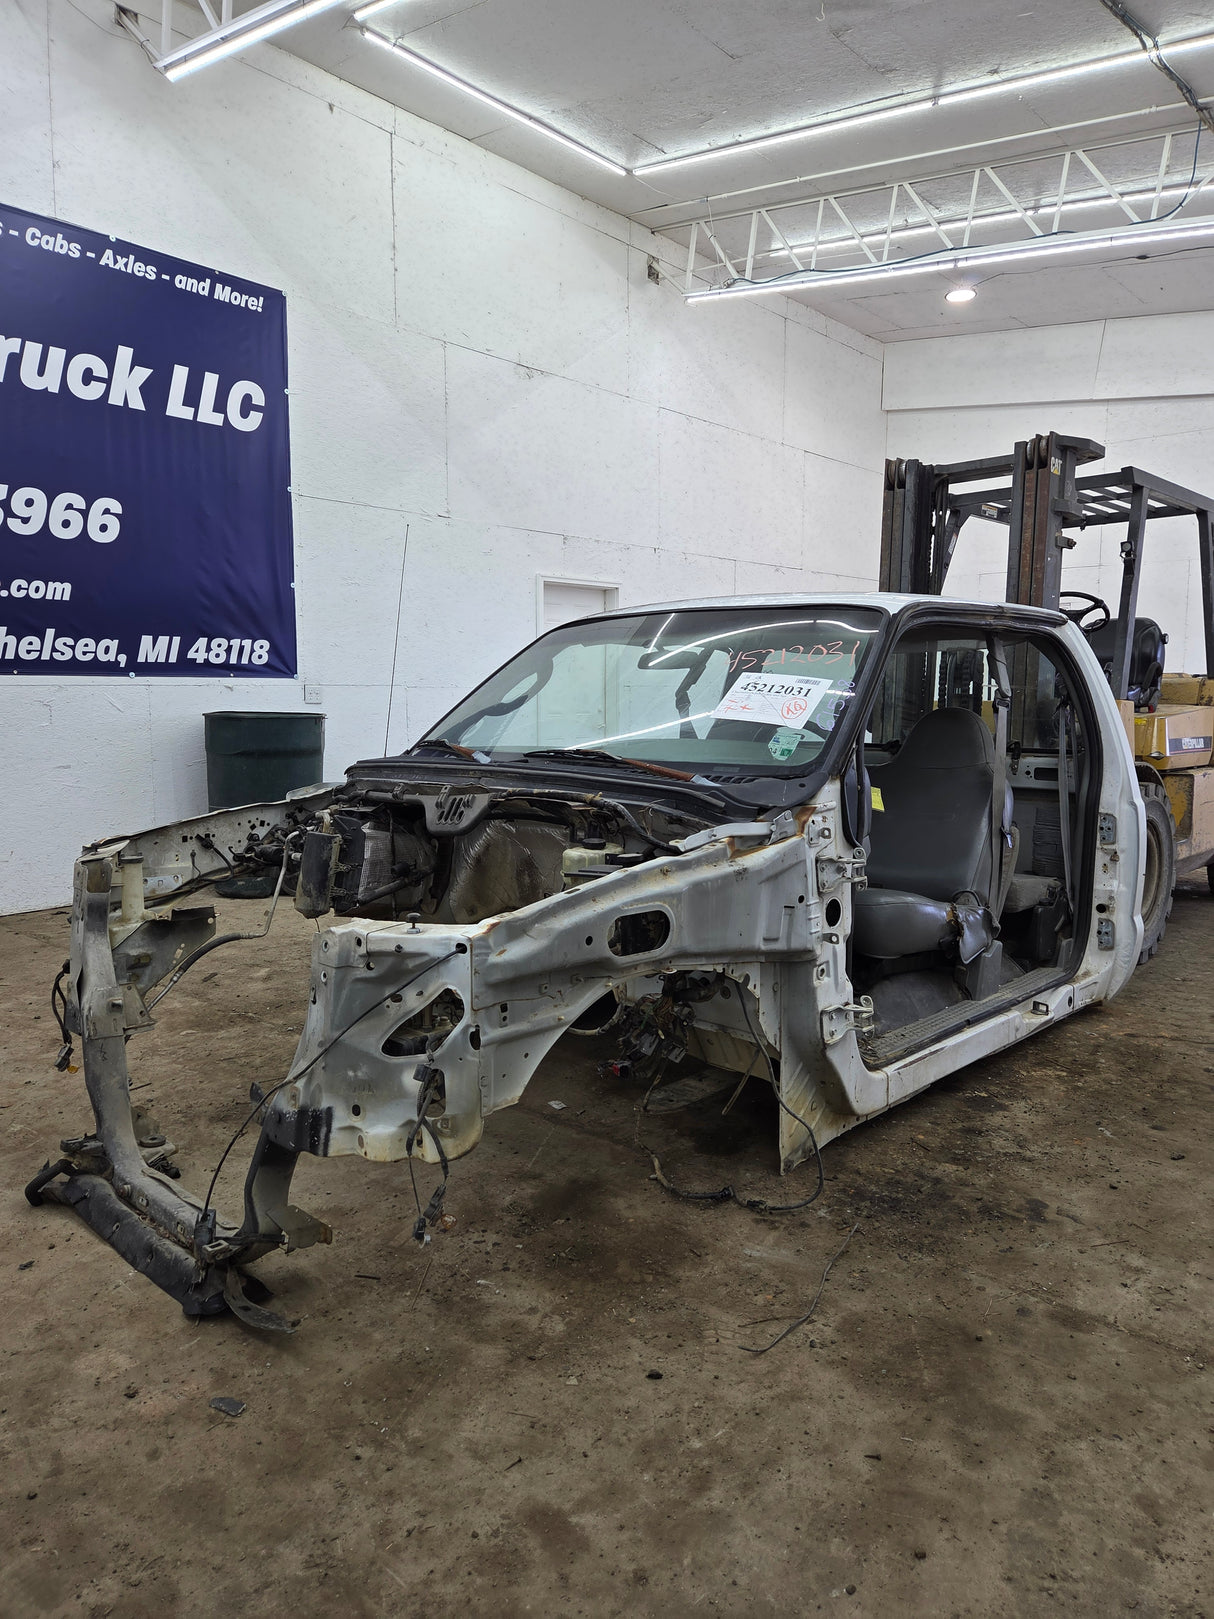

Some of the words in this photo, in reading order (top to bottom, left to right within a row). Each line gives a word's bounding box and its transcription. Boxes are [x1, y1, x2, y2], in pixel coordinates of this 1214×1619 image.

[25, 227, 82, 258] Cabs
[99, 249, 157, 280] Axles
[174, 273, 210, 296] and
[213, 283, 264, 312] More!
[165, 364, 266, 432] LLC
[1051, 456, 1063, 475] CAT
[137, 635, 181, 663] MI
[187, 637, 270, 665] 48118
[725, 640, 861, 673] 45212031
[740, 681, 812, 698] 45212031
